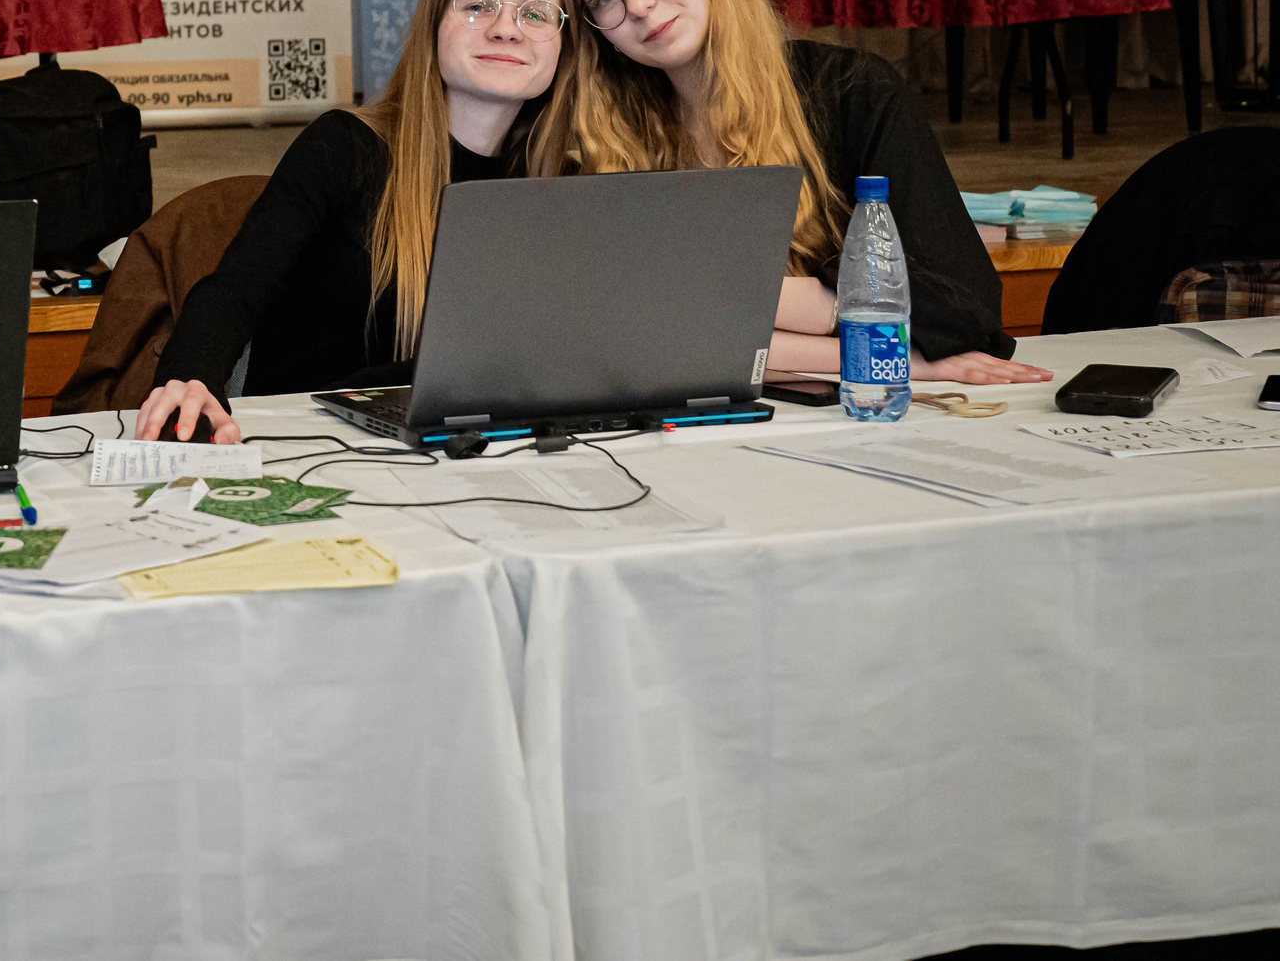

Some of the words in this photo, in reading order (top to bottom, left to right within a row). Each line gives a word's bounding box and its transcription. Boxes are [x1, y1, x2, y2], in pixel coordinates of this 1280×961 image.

[169, 23, 223, 38] НТОВ
[177, 90, 232, 107] vphs.ru
[753, 351, 765, 382] Lenovo
[871, 357, 907, 370] bona
[871, 368, 908, 382] aqua
